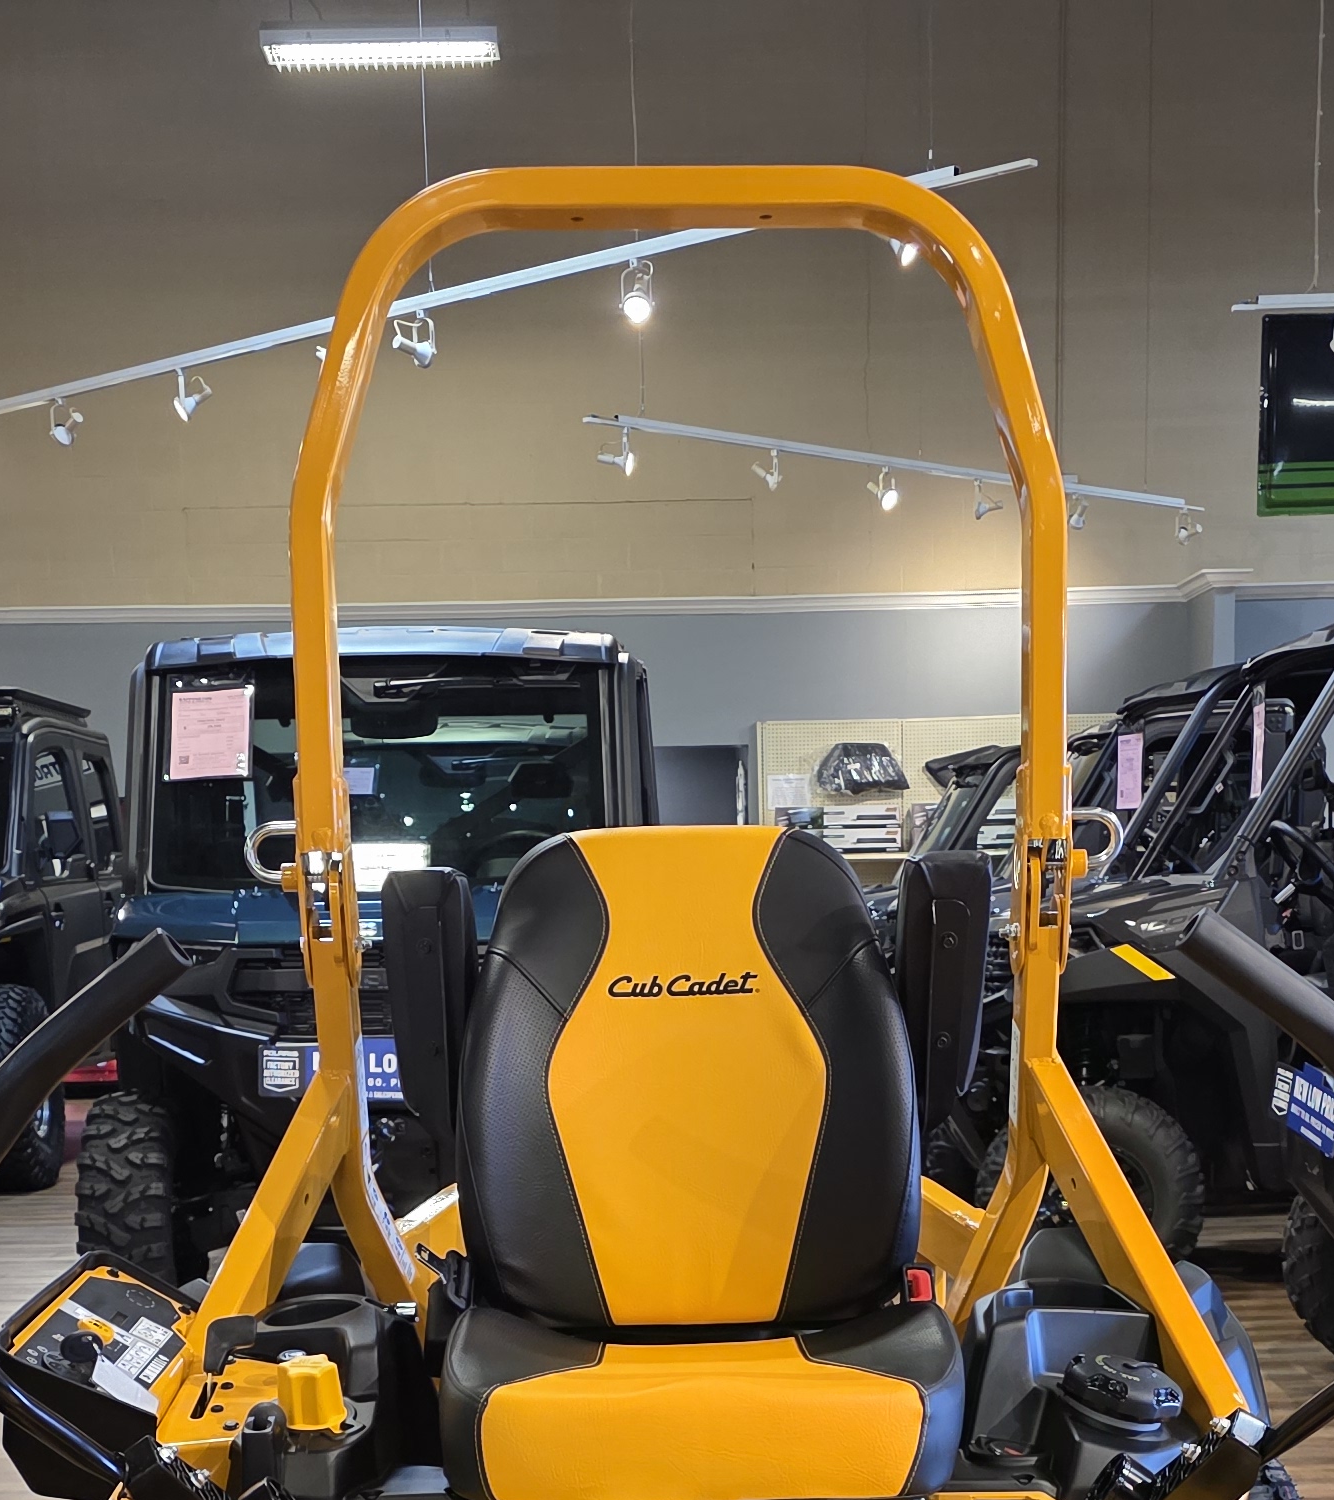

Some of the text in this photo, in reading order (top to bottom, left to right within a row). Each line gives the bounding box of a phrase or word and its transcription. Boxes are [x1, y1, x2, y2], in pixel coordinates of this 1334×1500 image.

[608, 971, 758, 998] Cub Cadet
[369, 1052, 399, 1073] LO
